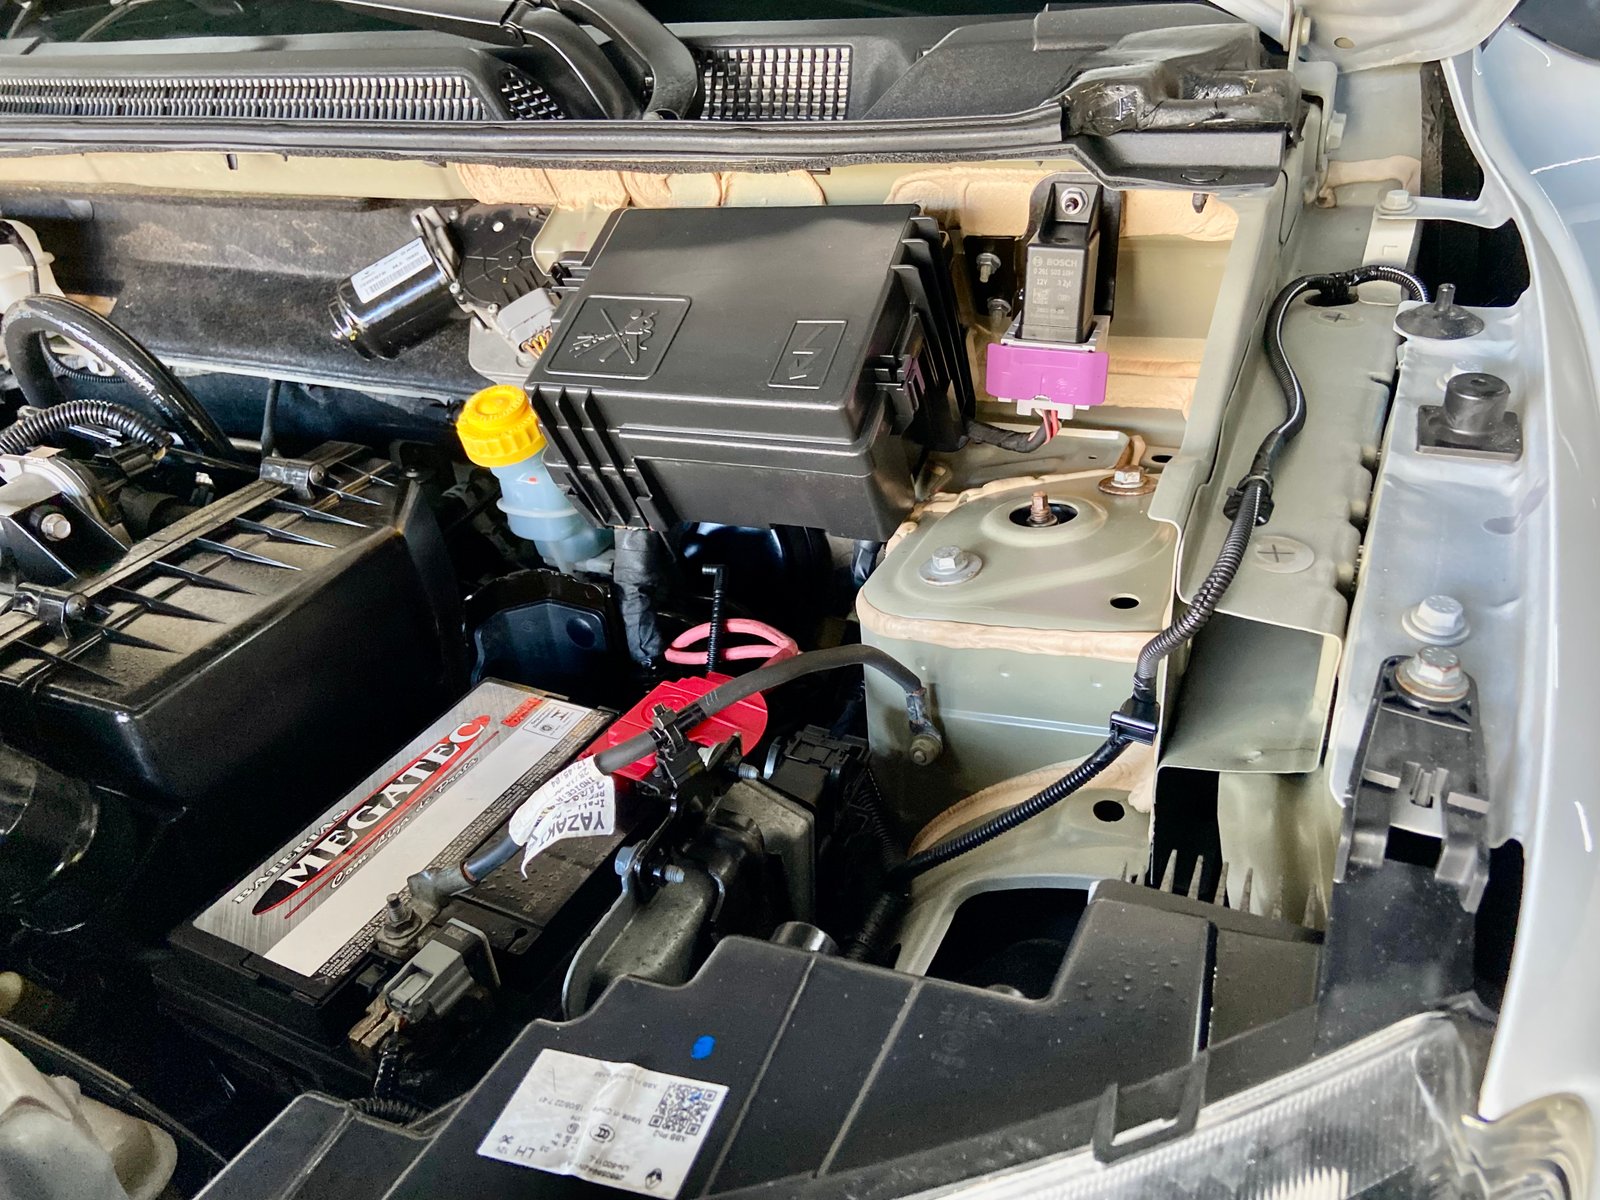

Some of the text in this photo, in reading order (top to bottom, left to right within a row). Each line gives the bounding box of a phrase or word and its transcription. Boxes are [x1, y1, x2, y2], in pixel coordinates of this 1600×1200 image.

[1046, 258, 1078, 267] BOSCH
[276, 722, 485, 889] MEGATEC
[331, 853, 369, 889] Com
[415, 796, 434, 812] de
[434, 757, 479, 793] Prata
[232, 809, 349, 904] BATERIAS
[515, 1145, 535, 1159] LH
